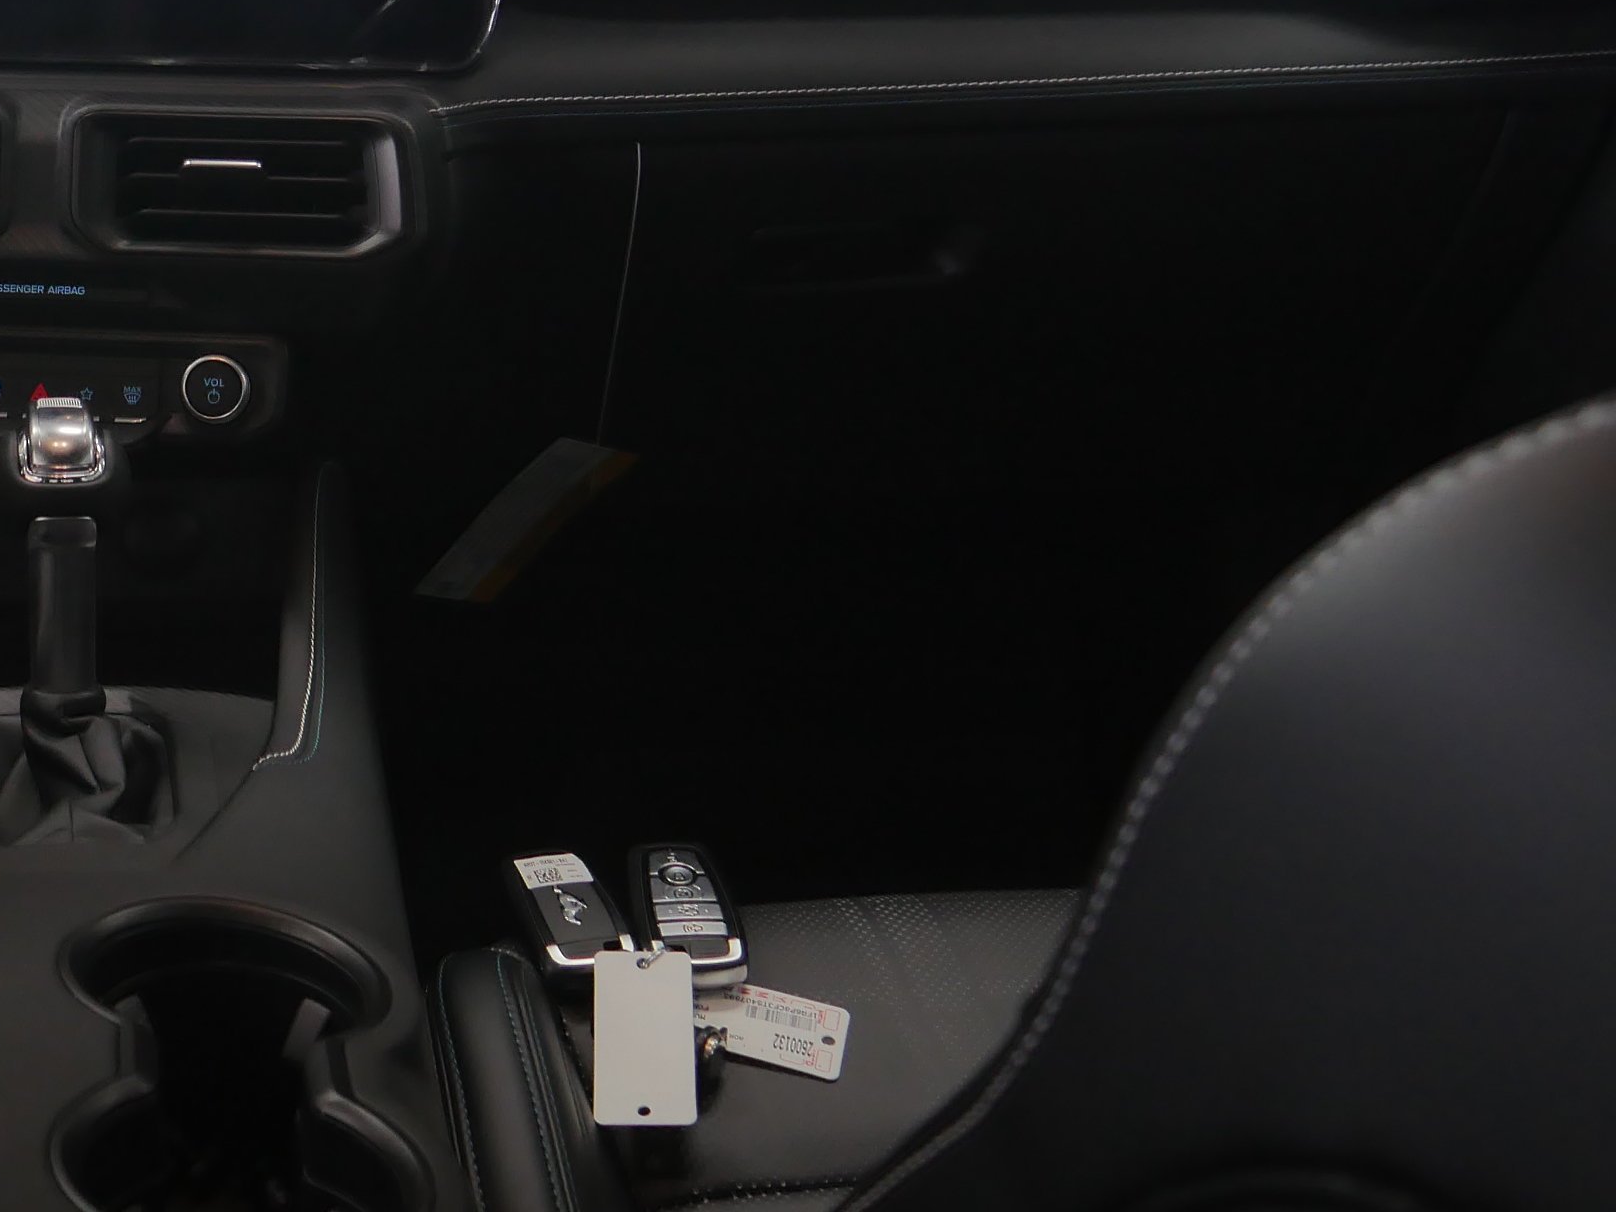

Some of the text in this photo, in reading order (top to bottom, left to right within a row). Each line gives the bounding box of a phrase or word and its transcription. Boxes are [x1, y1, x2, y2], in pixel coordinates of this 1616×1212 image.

[47, 284, 86, 296] AIRBAG
[204, 377, 224, 387] VOL
[772, 1032, 814, 1058] 2600132
